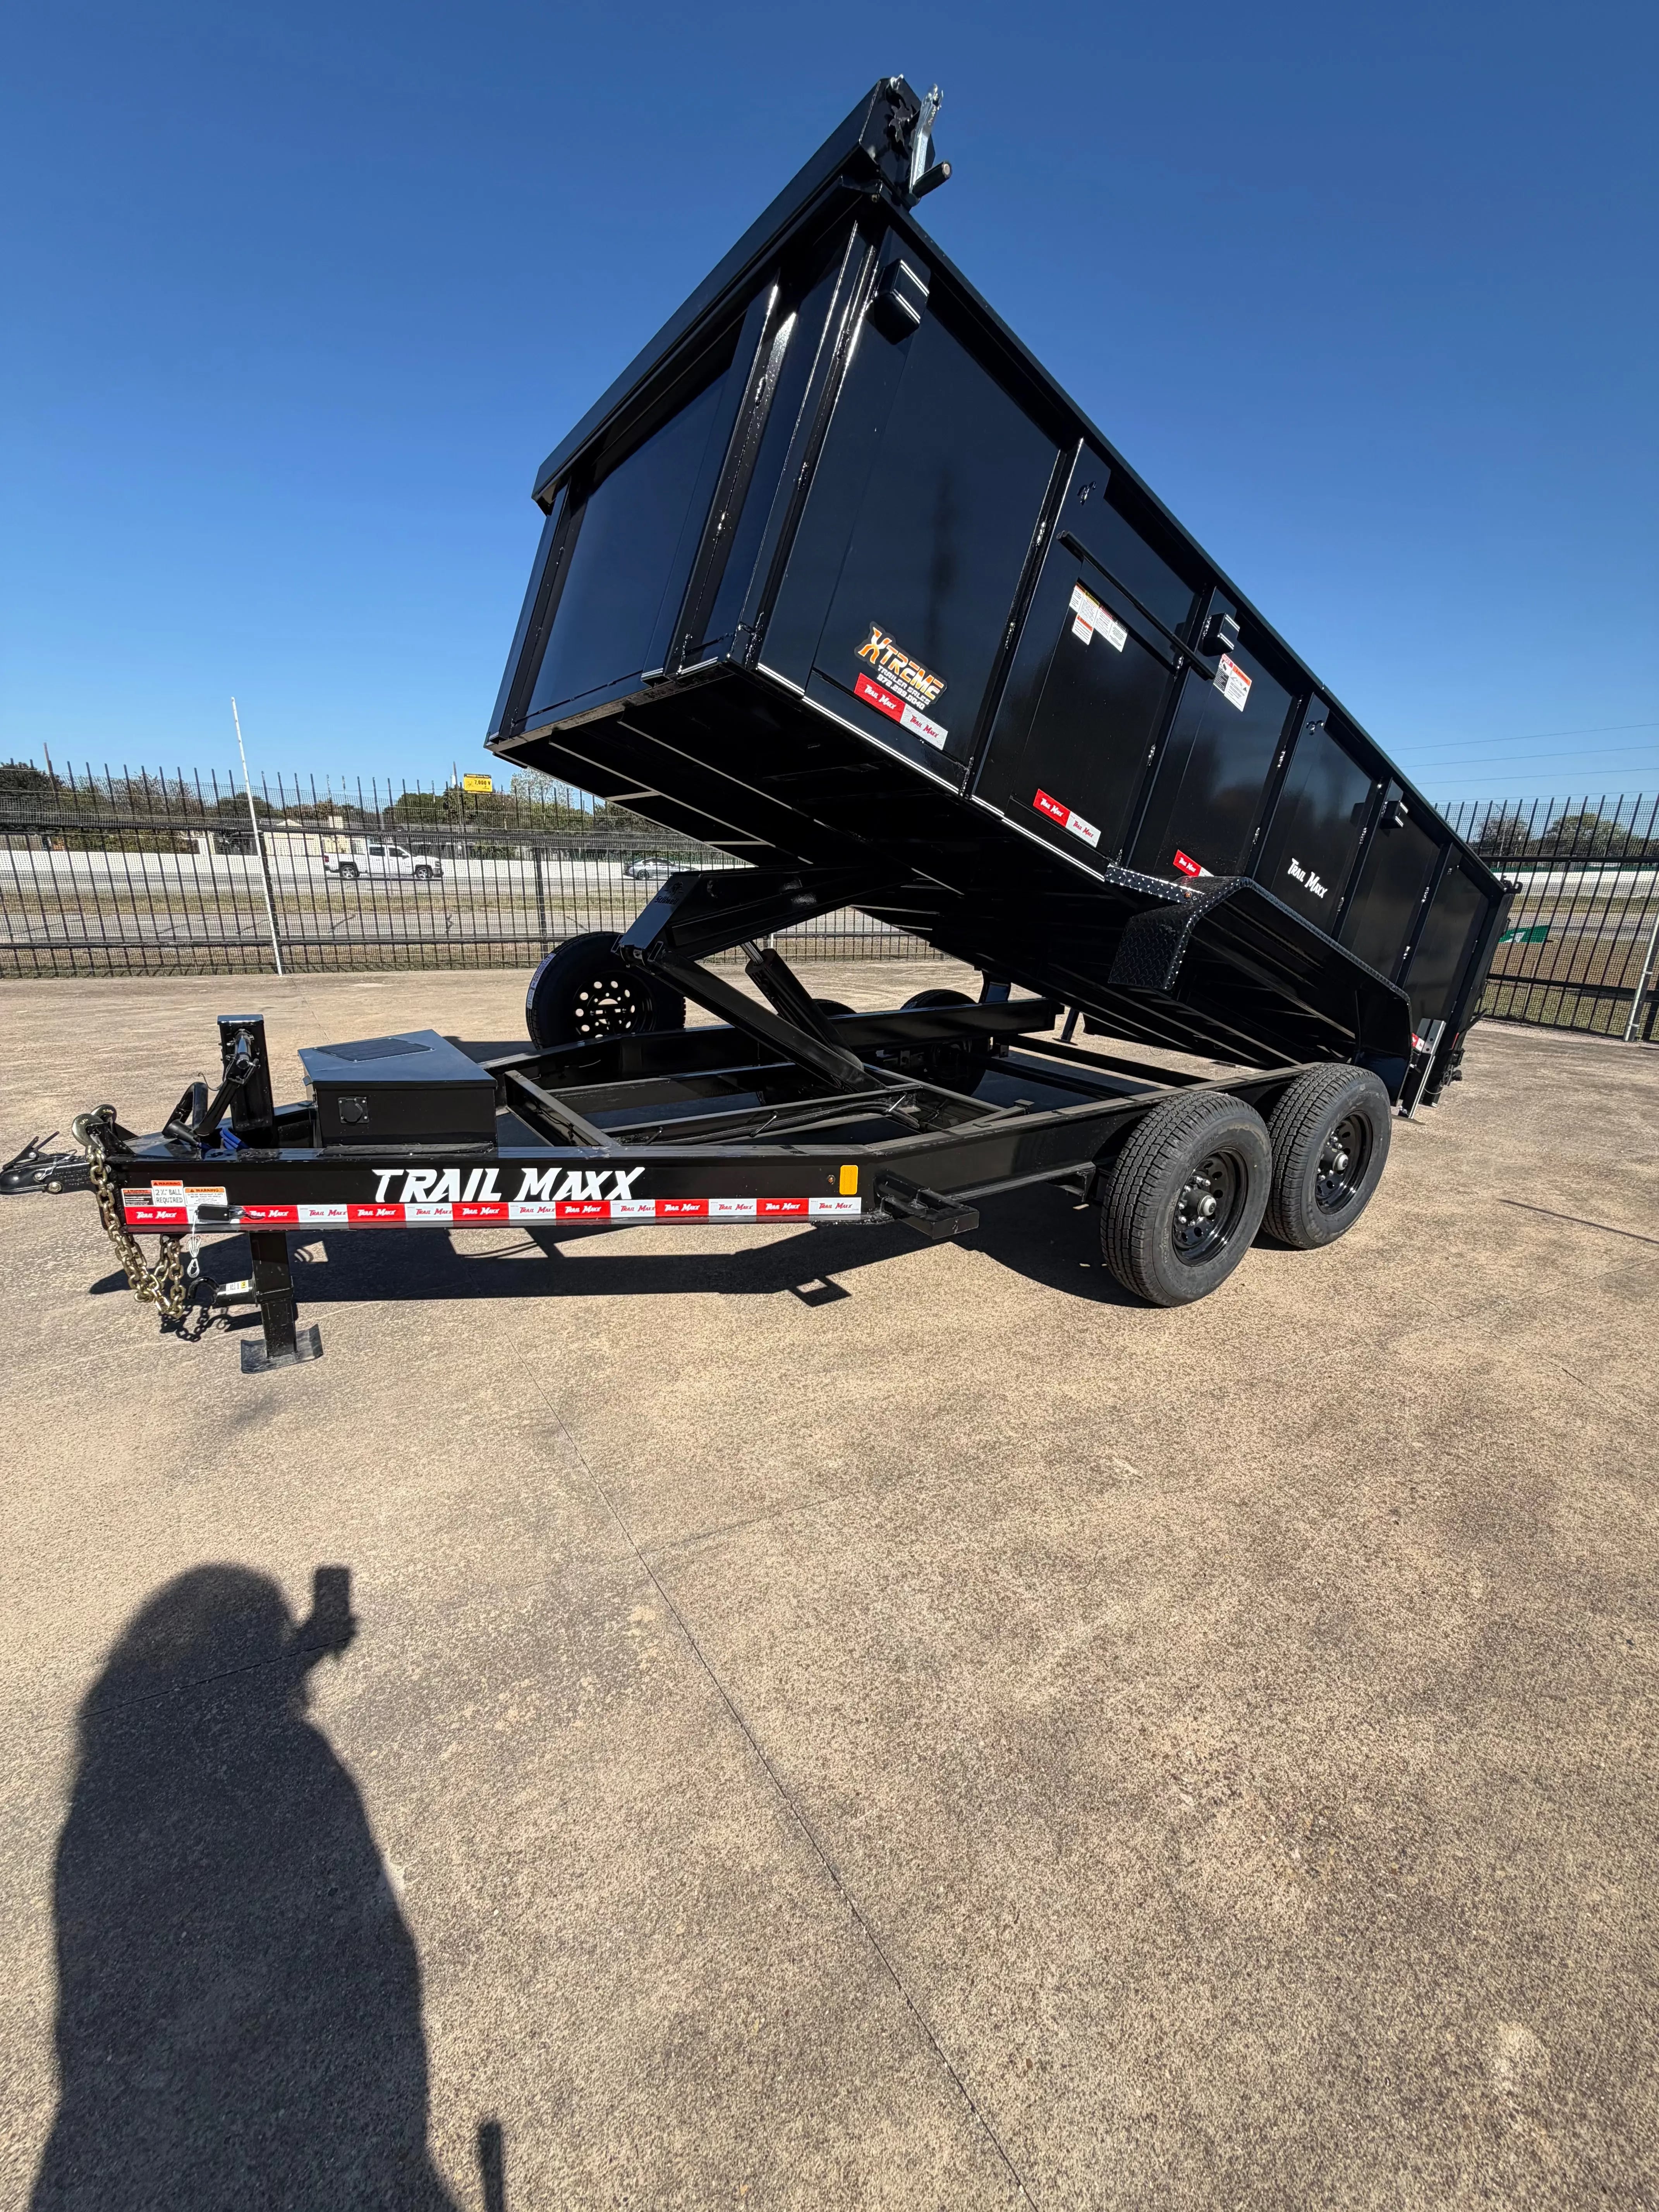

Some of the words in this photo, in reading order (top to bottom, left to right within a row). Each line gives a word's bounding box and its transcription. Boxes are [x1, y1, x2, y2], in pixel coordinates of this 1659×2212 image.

[858, 627, 943, 700] XTREME
[878, 665, 907, 689] TRAILER
[907, 686, 931, 705] SALES
[371, 1168, 501, 1202] TRAIL
[514, 1167, 645, 1201] MAXX
